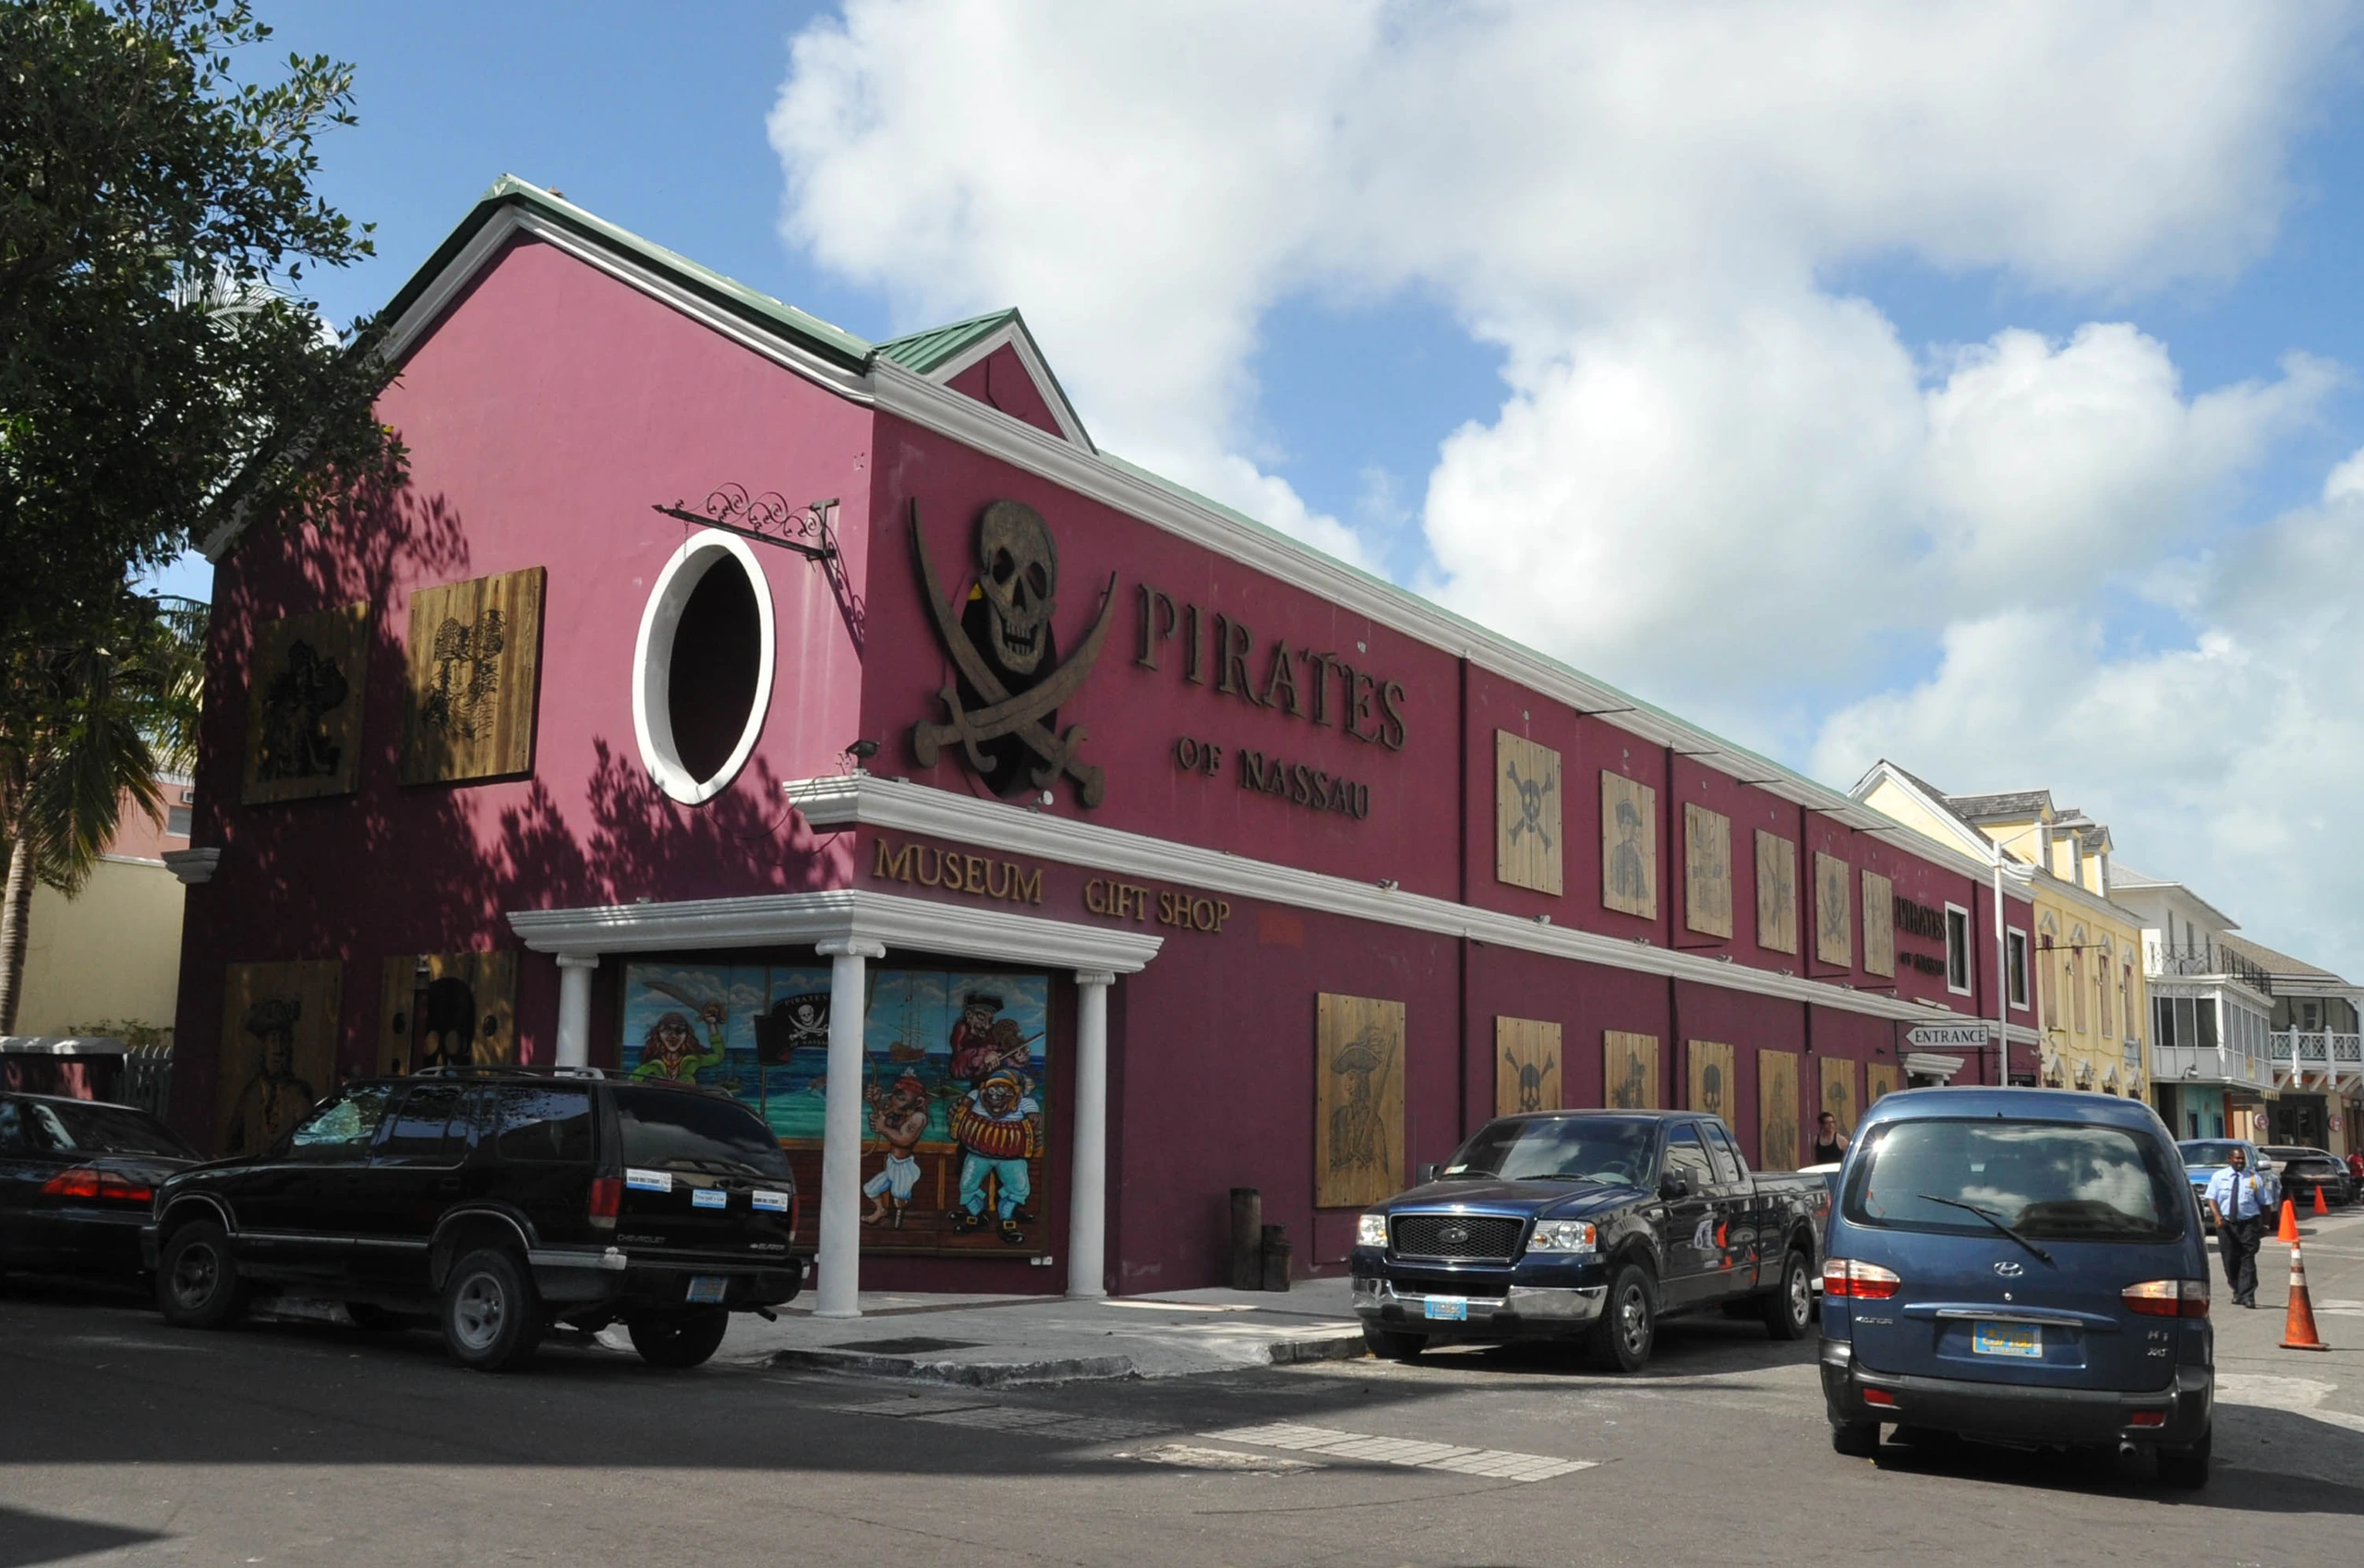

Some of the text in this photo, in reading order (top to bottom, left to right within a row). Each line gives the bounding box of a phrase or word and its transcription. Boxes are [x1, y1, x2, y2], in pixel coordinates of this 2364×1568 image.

[1137, 583, 1406, 752] PIRATES
[1173, 736, 1369, 820] OF NASSAU
[873, 838, 1230, 933] MUSEUM GIFT SHOP
[1894, 896, 1946, 940] PIRATES
[1914, 1029, 1986, 1044] ENTRANCE
